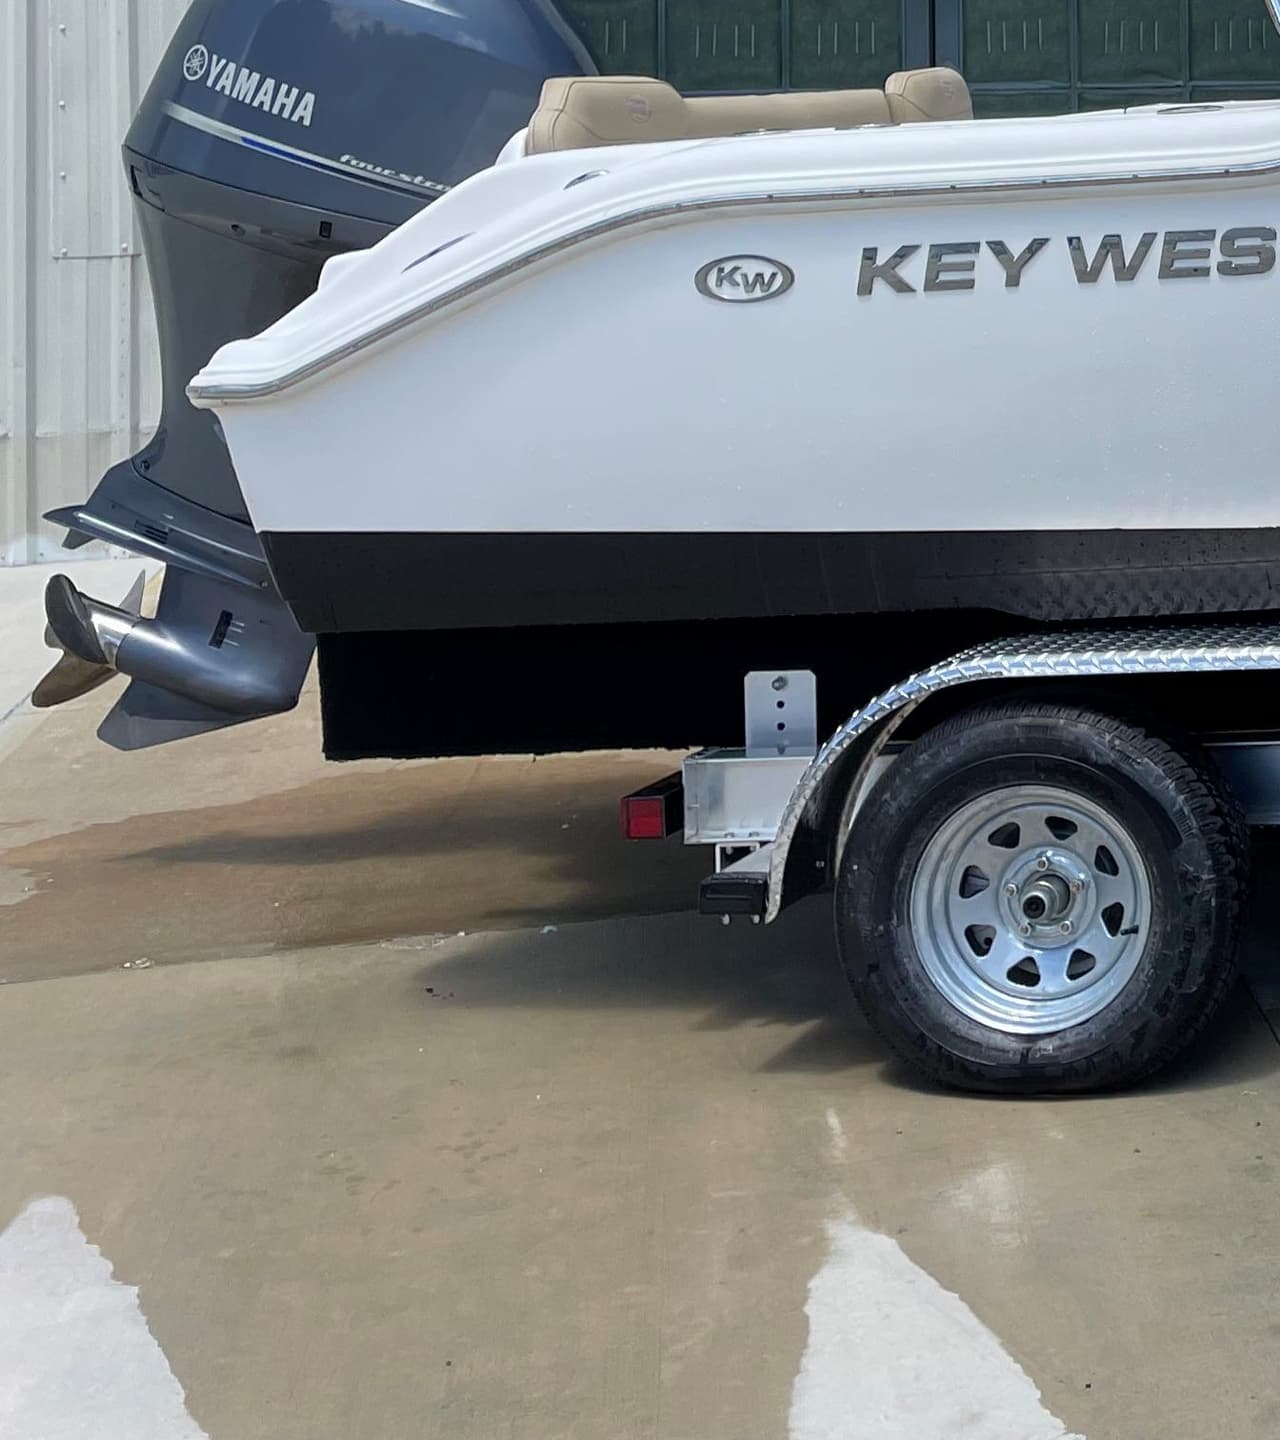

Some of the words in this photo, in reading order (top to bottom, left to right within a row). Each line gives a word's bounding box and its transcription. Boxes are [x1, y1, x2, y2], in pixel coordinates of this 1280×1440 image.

[206, 53, 315, 127] YAMAHA
[715, 265, 778, 294] KW
[857, 238, 1051, 296] KEY
